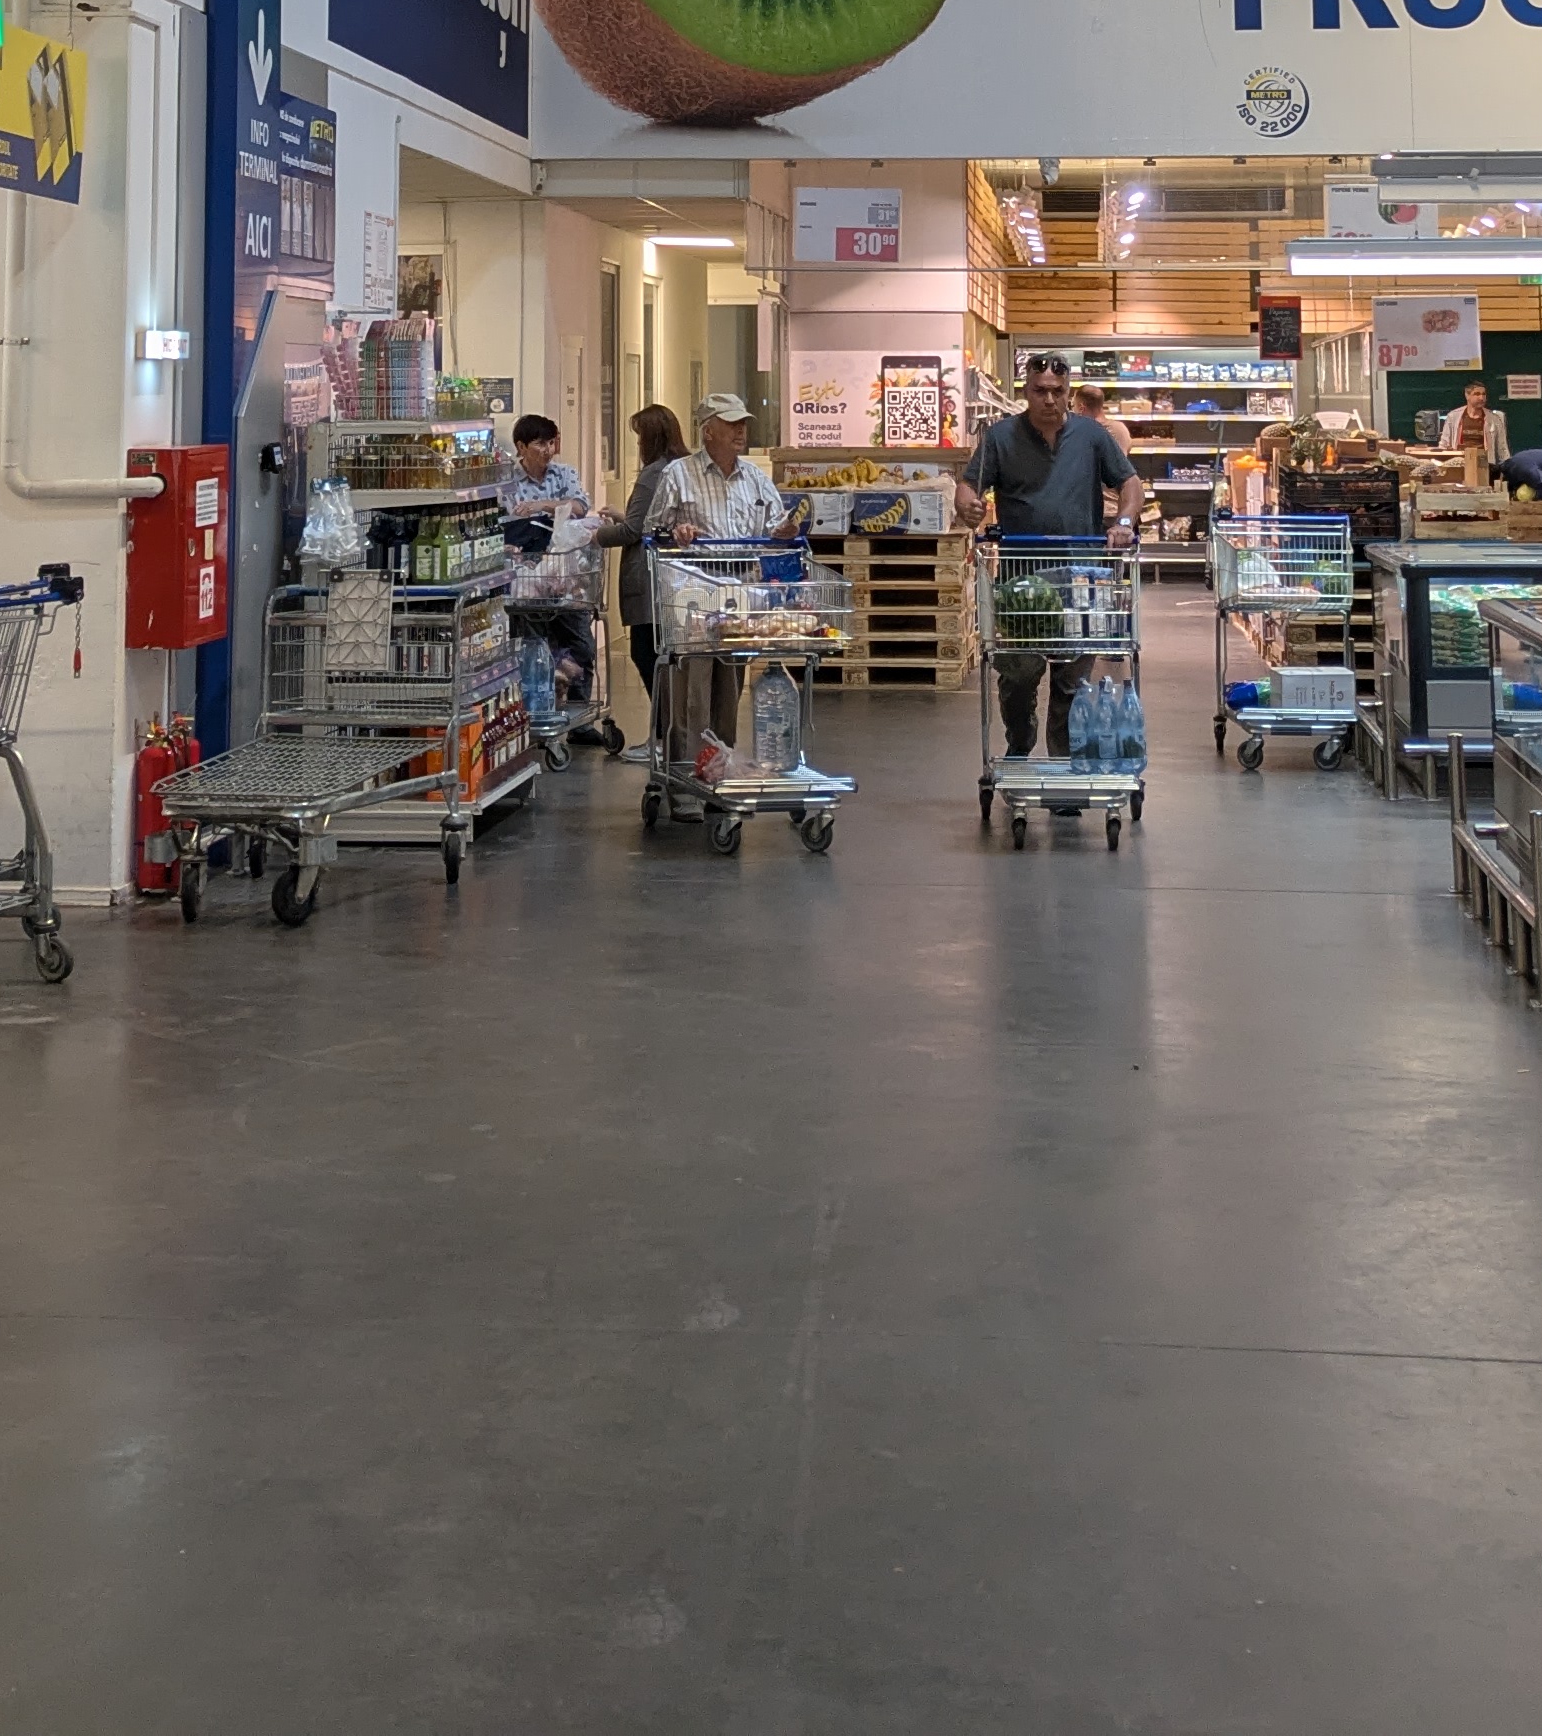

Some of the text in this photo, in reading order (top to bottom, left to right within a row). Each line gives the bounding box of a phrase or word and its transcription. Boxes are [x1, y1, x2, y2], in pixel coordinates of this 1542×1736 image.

[1244, 67, 1295, 85] CERTIFIED
[1236, 104, 1302, 132] ISO 22000
[250, 119, 270, 148] INFO
[239, 151, 278, 185] TERMINAL
[245, 213, 272, 259] AICI
[793, 402, 847, 414] QRios?
[798, 432, 841, 440] QR codul
